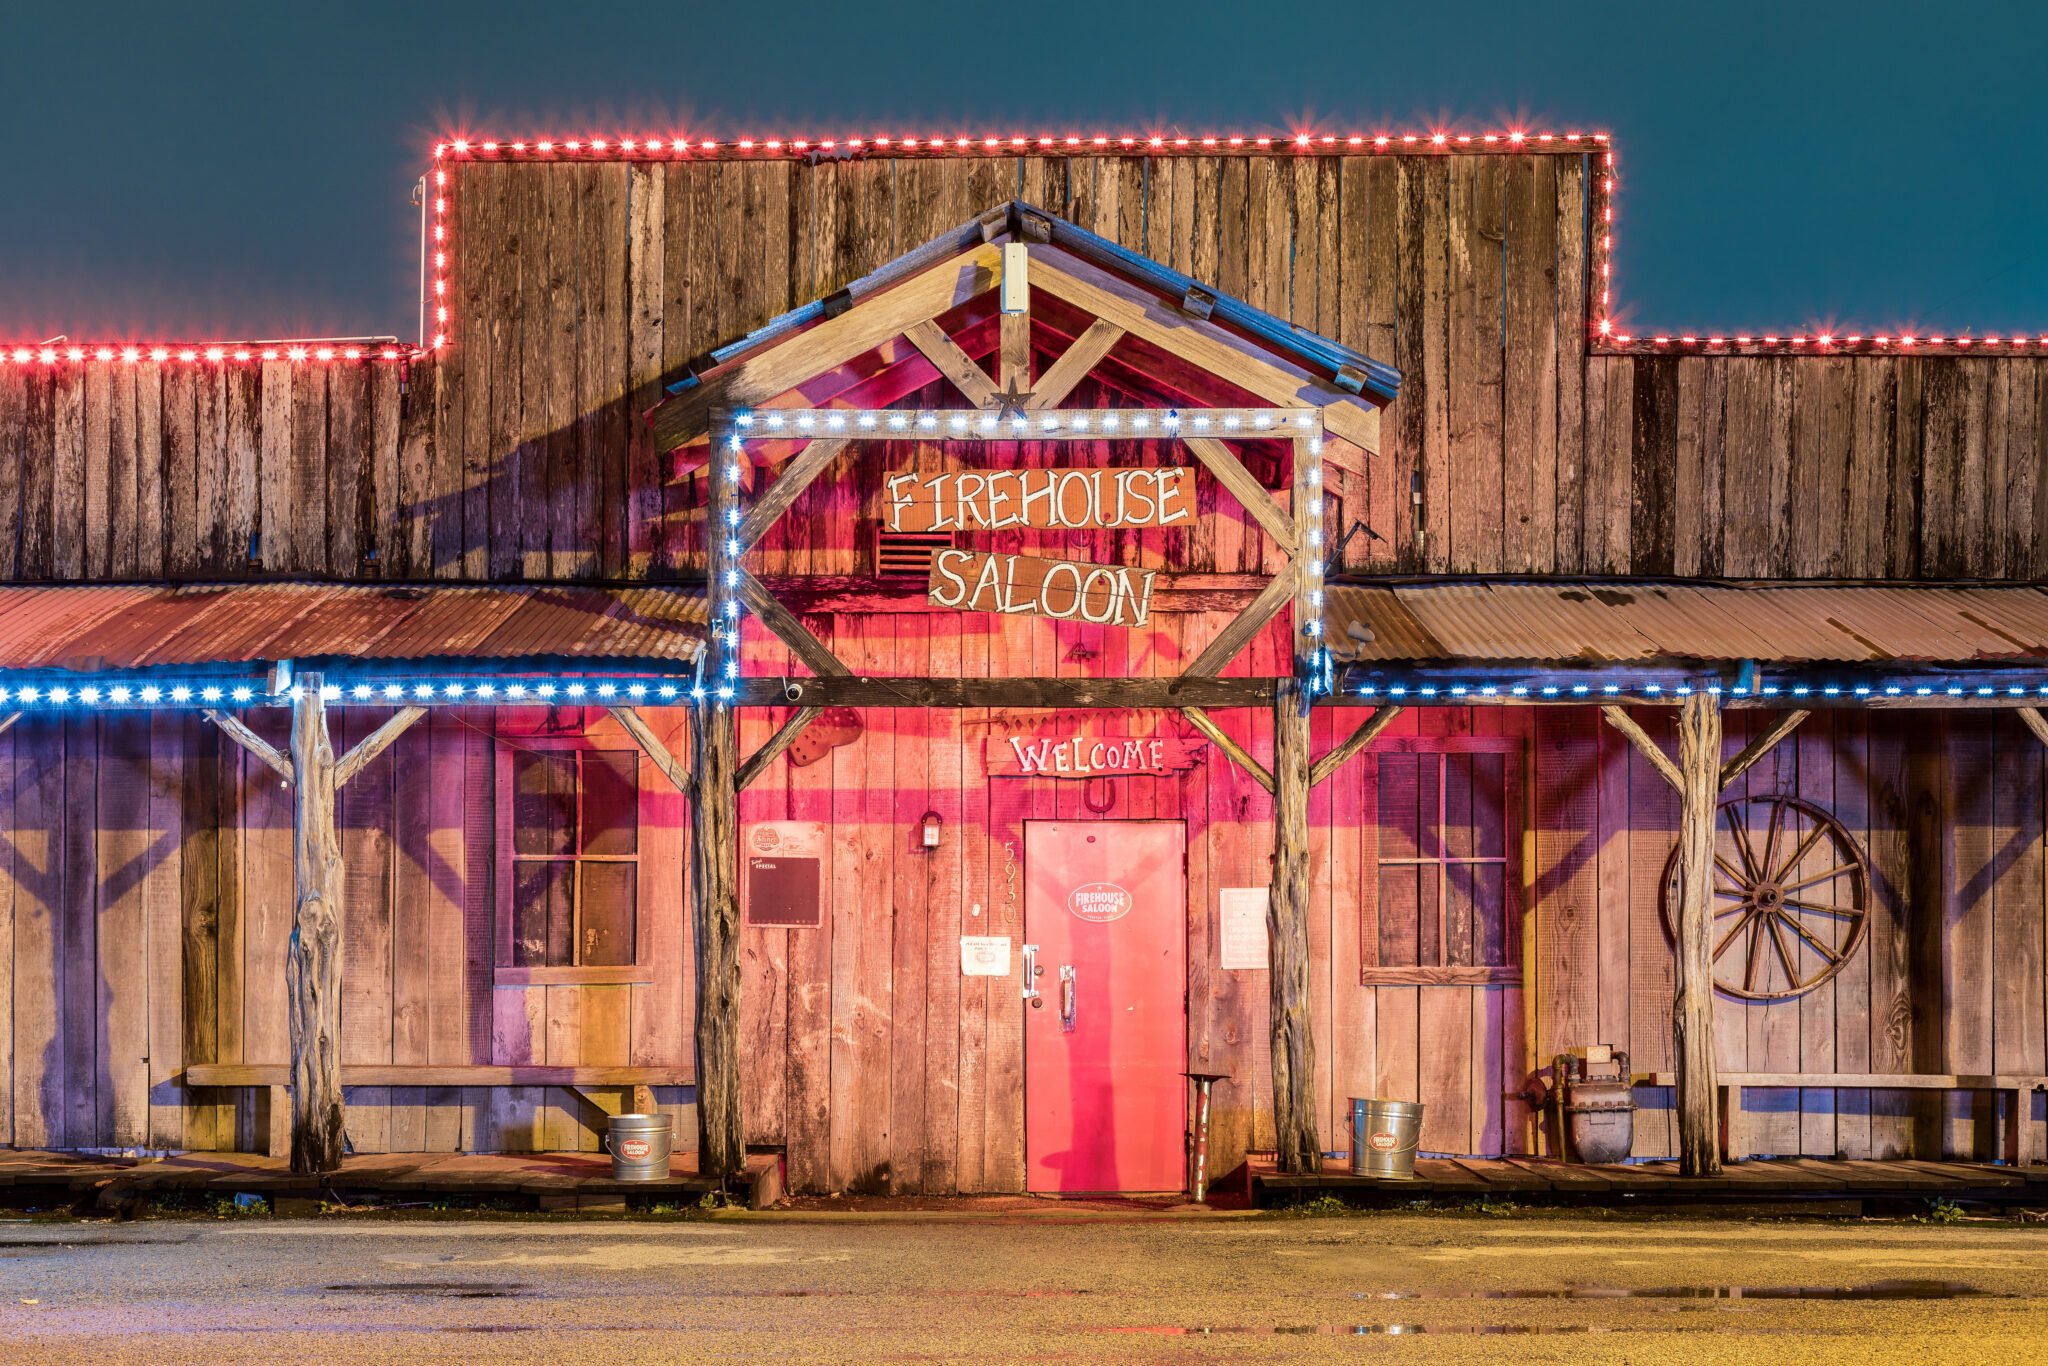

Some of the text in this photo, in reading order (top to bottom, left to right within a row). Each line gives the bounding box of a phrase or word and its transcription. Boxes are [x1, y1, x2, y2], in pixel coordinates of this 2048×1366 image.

[886, 467, 1189, 532] FIREHOUSE
[929, 550, 1156, 627] SALOON
[1009, 736, 1164, 773] WELCOME
[1004, 841, 1016, 923] 5930
[1075, 892, 1125, 907] FIREHOUSE
[1082, 903, 1118, 913] SALOON
